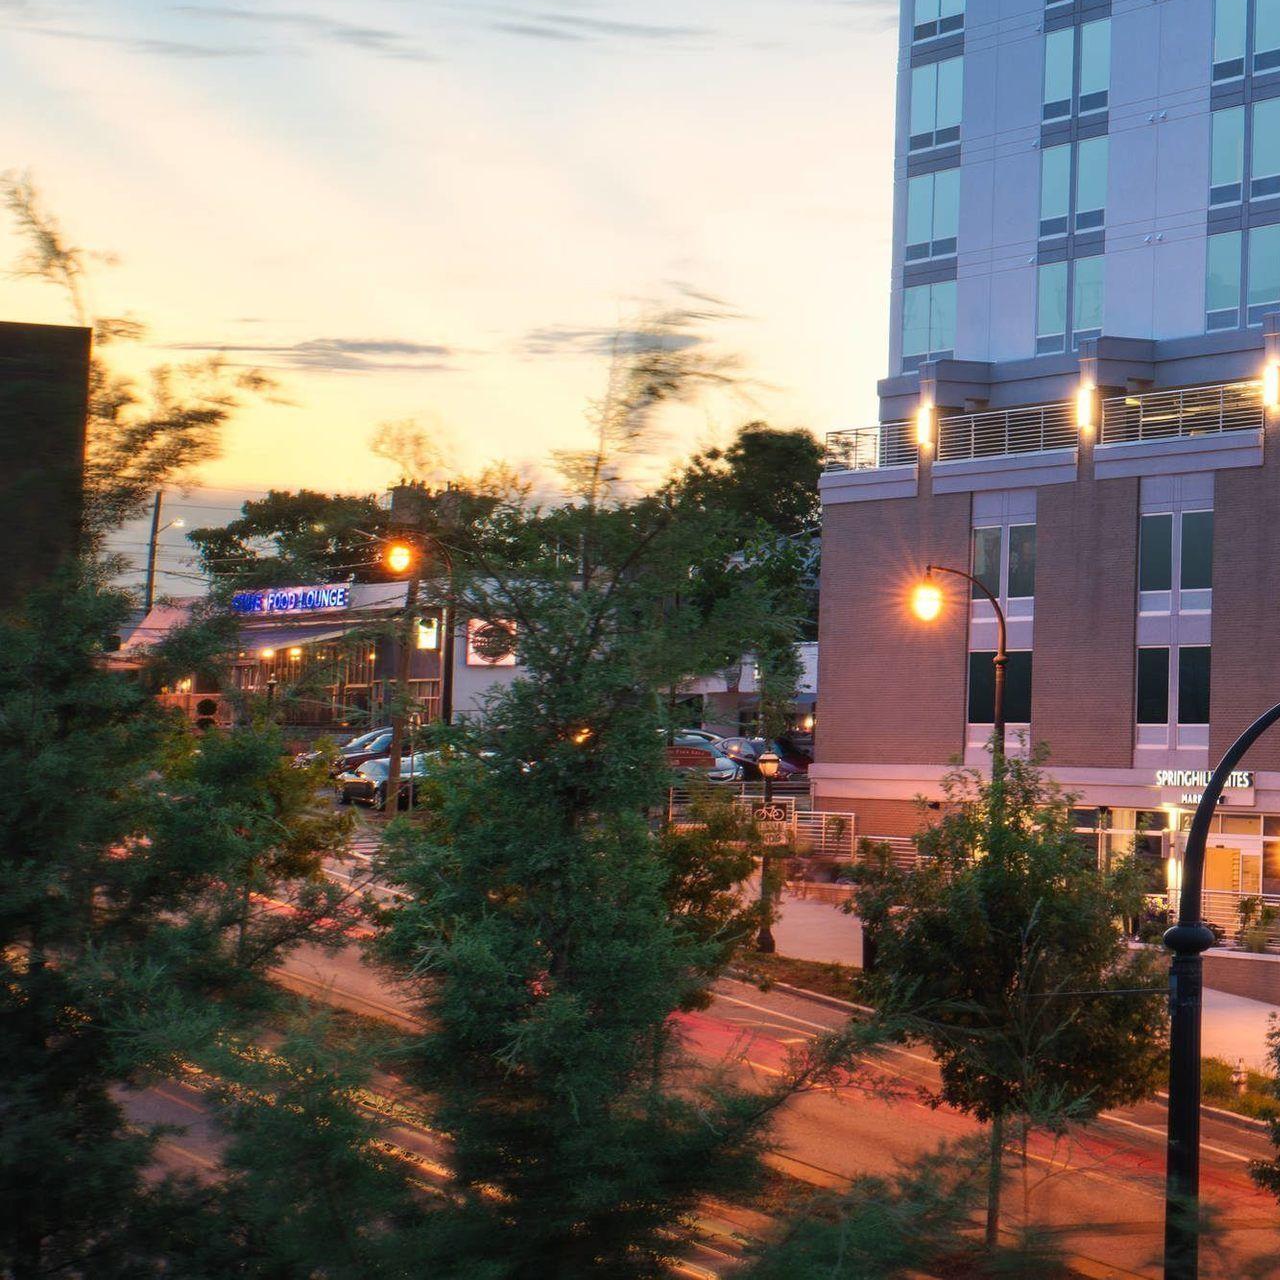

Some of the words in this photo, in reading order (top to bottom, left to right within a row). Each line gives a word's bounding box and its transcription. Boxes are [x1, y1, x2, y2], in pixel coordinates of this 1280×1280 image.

[267, 592, 296, 610] FOOD
[299, 588, 345, 609] LOUNGE
[1223, 771, 1251, 788] ITES
